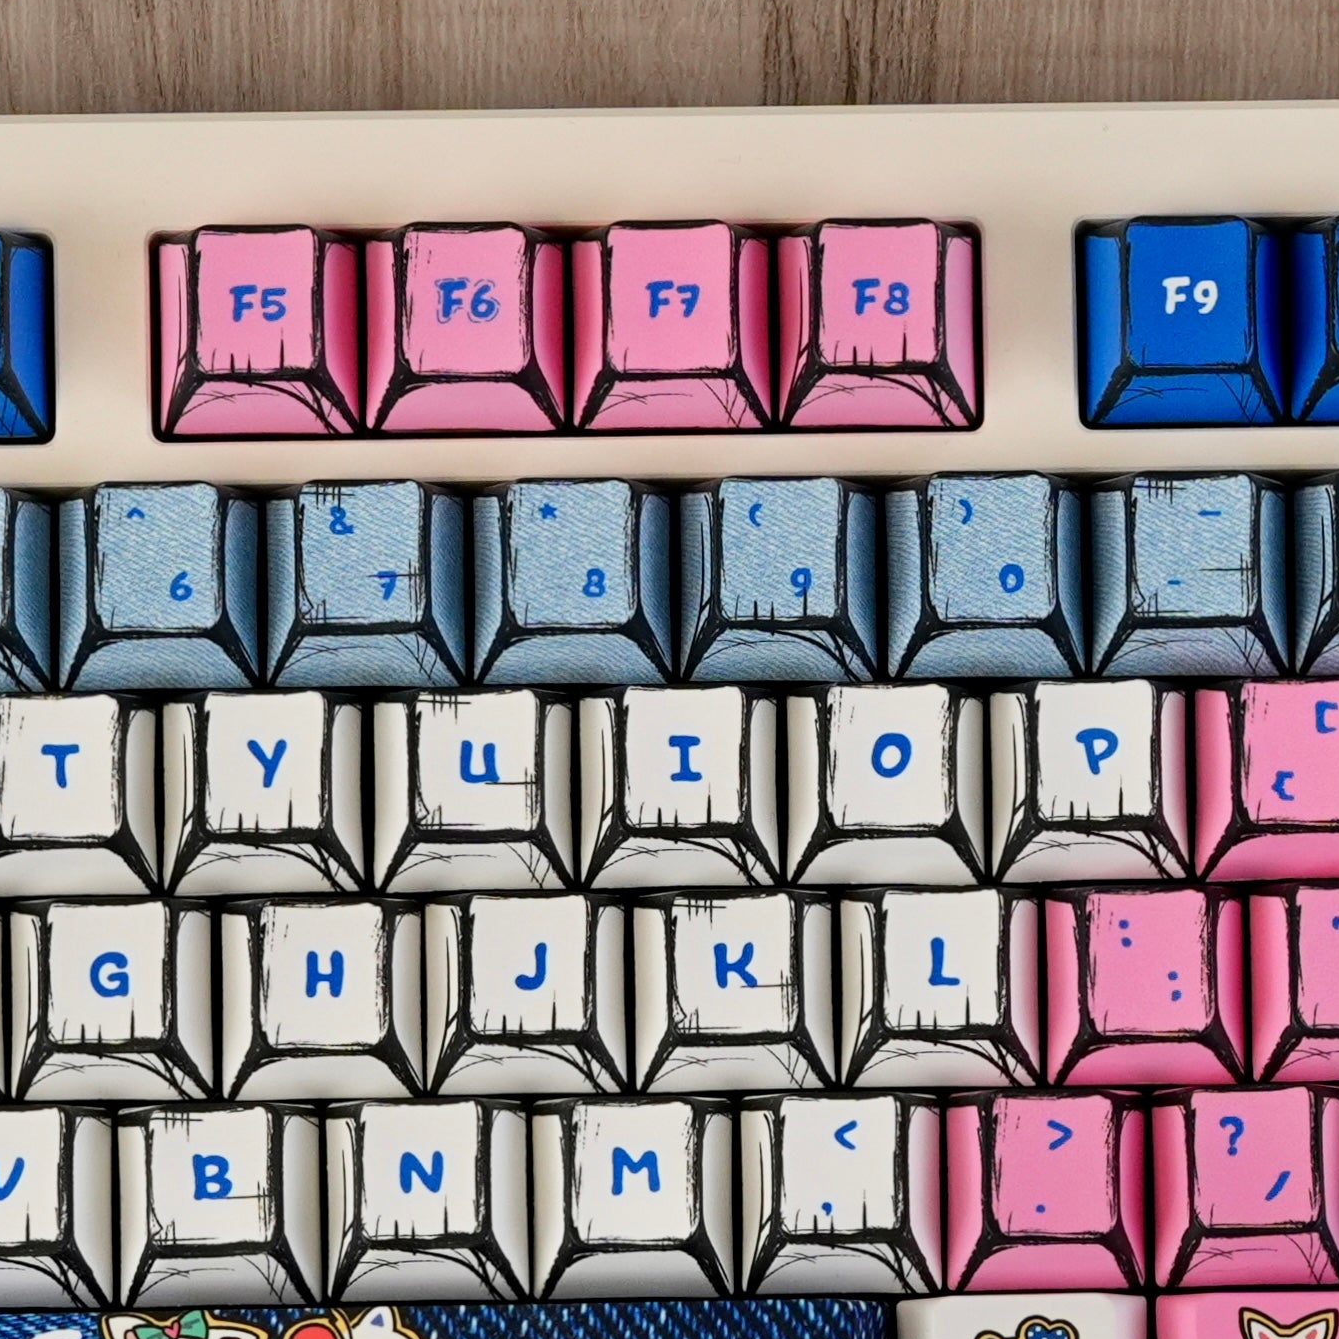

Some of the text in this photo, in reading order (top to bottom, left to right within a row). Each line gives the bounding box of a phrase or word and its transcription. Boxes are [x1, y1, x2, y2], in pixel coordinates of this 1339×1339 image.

[231, 284, 287, 322] F5
[436, 276, 500, 323] F6
[647, 280, 700, 318] F7
[853, 278, 910, 316] F8
[1163, 276, 1219, 314] F9
[169, 571, 193, 602] 6
[376, 571, 399, 600] 7
[582, 568, 606, 598] 8
[790, 567, 812, 598] 9
[998, 563, 1025, 594] 0
[41, 744, 80, 788] T
[247, 739, 288, 788] Y
[460, 740, 501, 784] U
[668, 735, 703, 782] I
[871, 732, 913, 778] O
[1075, 727, 1119, 775] P
[89, 951, 130, 998] G
[306, 950, 345, 998] H
[515, 942, 548, 991] J
[713, 942, 758, 989] K
[928, 937, 961, 986] L
[192, 1154, 233, 1201] B
[399, 1151, 444, 1194] N
[612, 1147, 661, 1196] M
